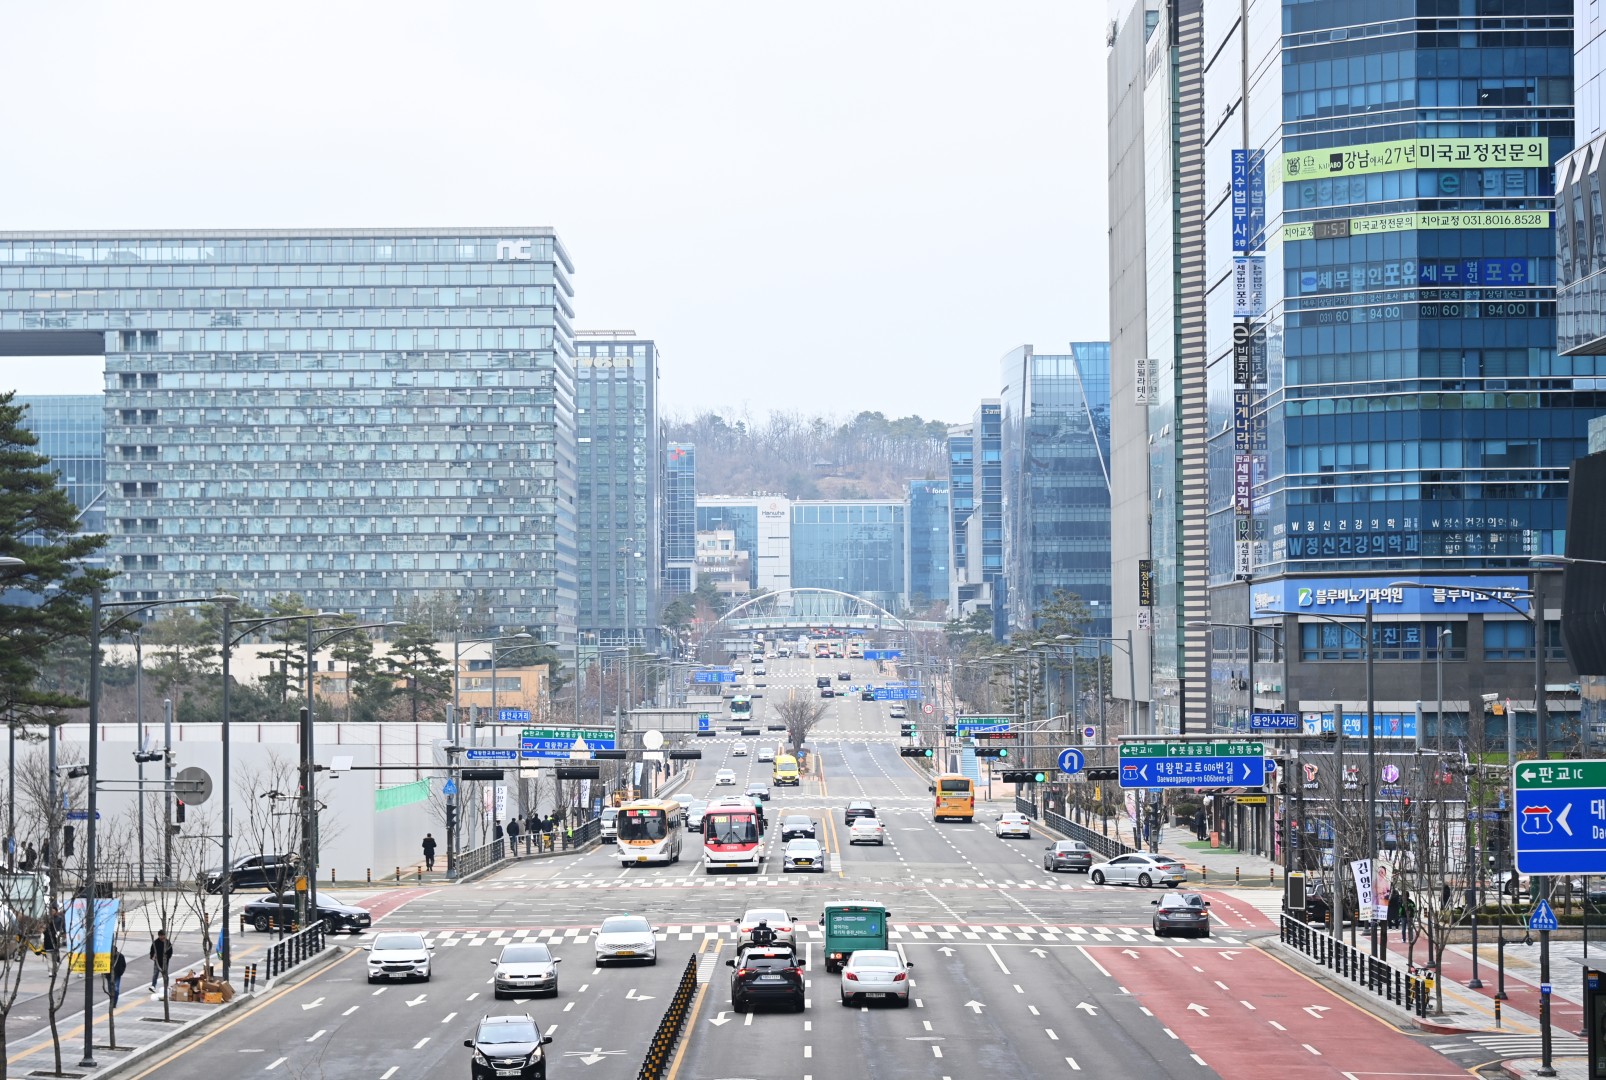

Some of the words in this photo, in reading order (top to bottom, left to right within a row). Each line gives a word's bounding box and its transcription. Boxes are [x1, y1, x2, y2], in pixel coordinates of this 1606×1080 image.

[1420, 143, 1543, 162] 미국교정전문의
[1353, 216, 1413, 232] 미국교정전문의
[1421, 215, 1459, 227] 치아교정
[1462, 215, 1542, 226] 031.8016.8528
[1284, 226, 1314, 238] 치아교정
[1315, 587, 1403, 605] 블루비뇨기과의원
[1252, 715, 1297, 727] 동안사거리
